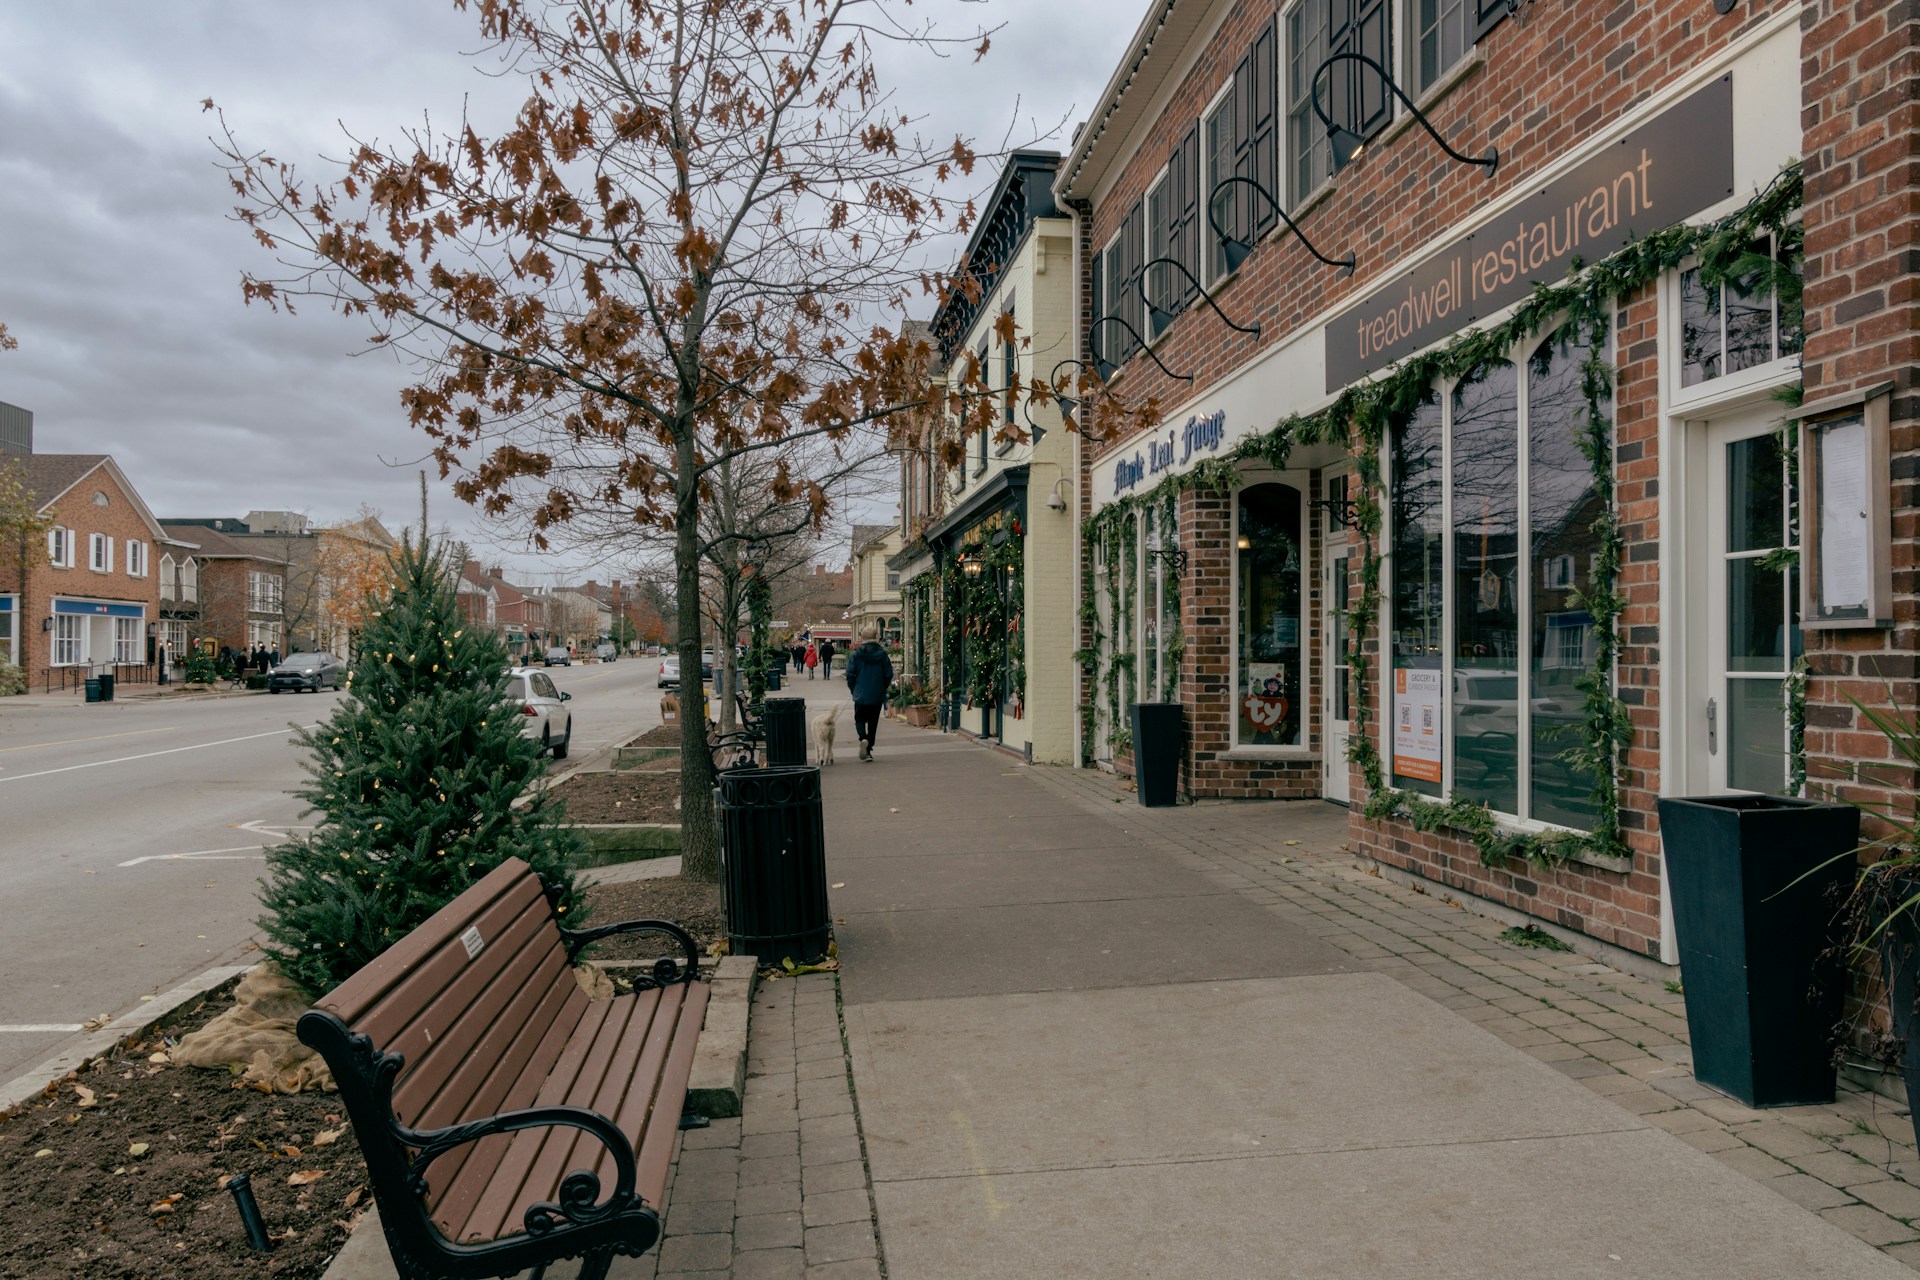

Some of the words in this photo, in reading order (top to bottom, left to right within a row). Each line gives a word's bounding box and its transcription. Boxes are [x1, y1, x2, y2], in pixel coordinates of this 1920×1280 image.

[1357, 257, 1461, 360] treadwell
[1471, 148, 1653, 299] restaurant
[1113, 450, 1145, 496] Maple
[1148, 429, 1175, 475] Leaf
[1179, 409, 1225, 466] Fudge
[1411, 674, 1431, 682] GROCERY
[1245, 697, 1282, 726] ty
